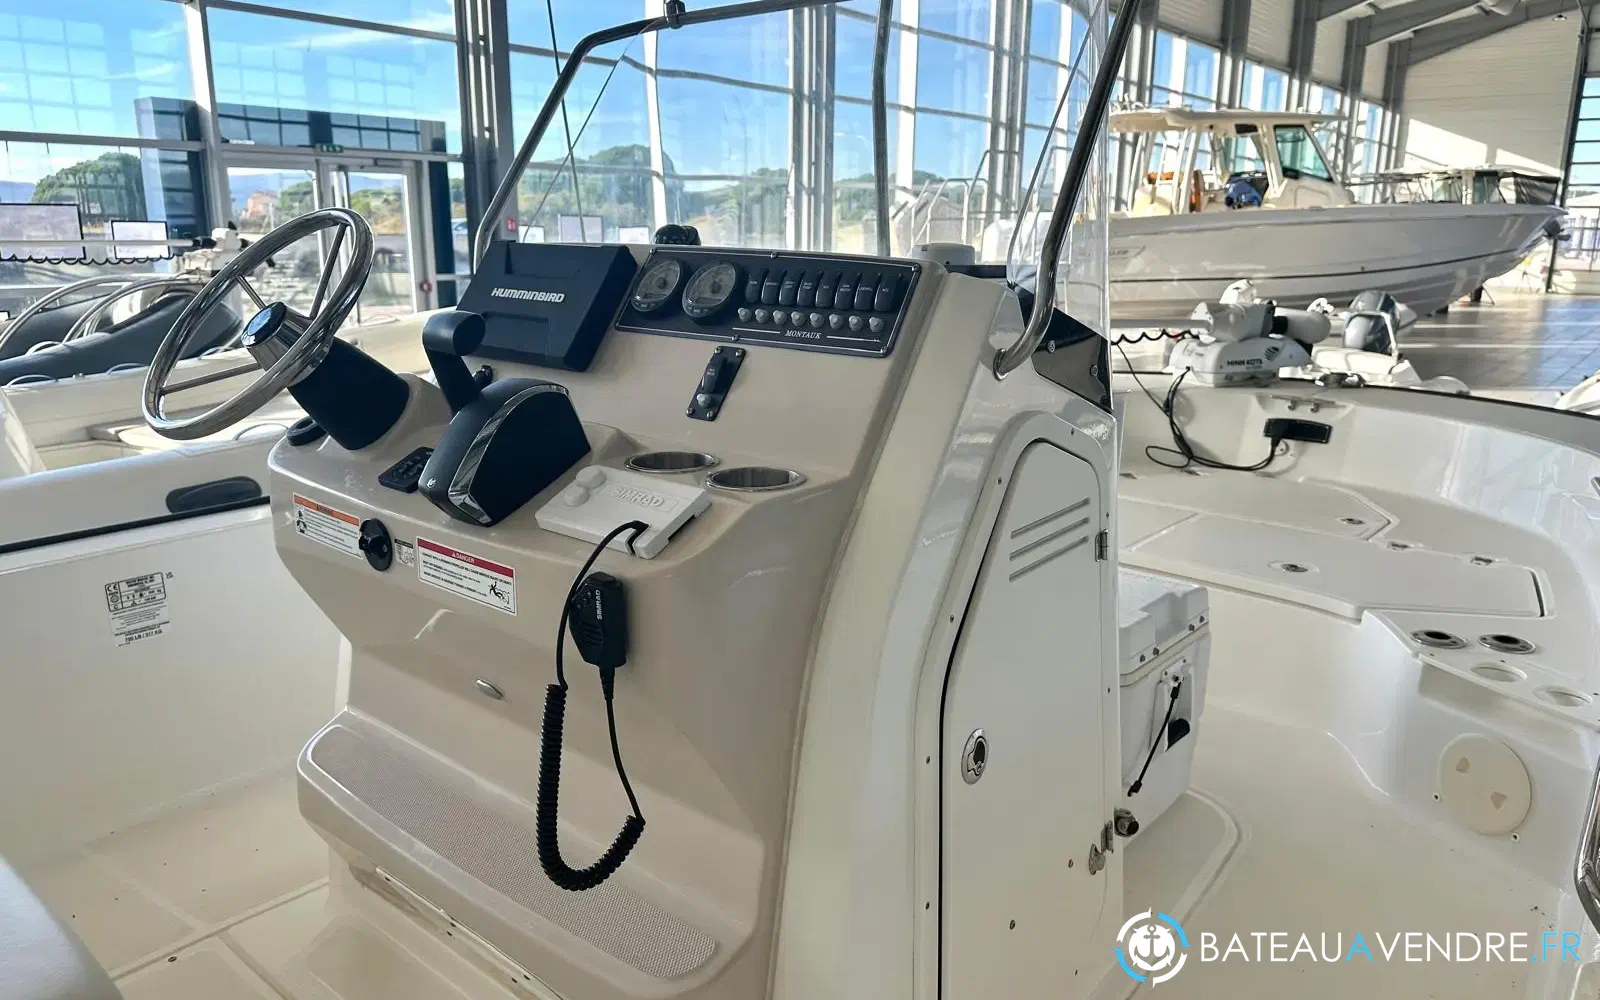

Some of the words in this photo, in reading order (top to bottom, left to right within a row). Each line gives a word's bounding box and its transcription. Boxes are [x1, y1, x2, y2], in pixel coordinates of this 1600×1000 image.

[491, 287, 565, 303] HUMMINBIRD
[784, 330, 822, 340] MONTAUK
[611, 485, 665, 508] SIMRAD
[456, 552, 475, 564] DANGER
